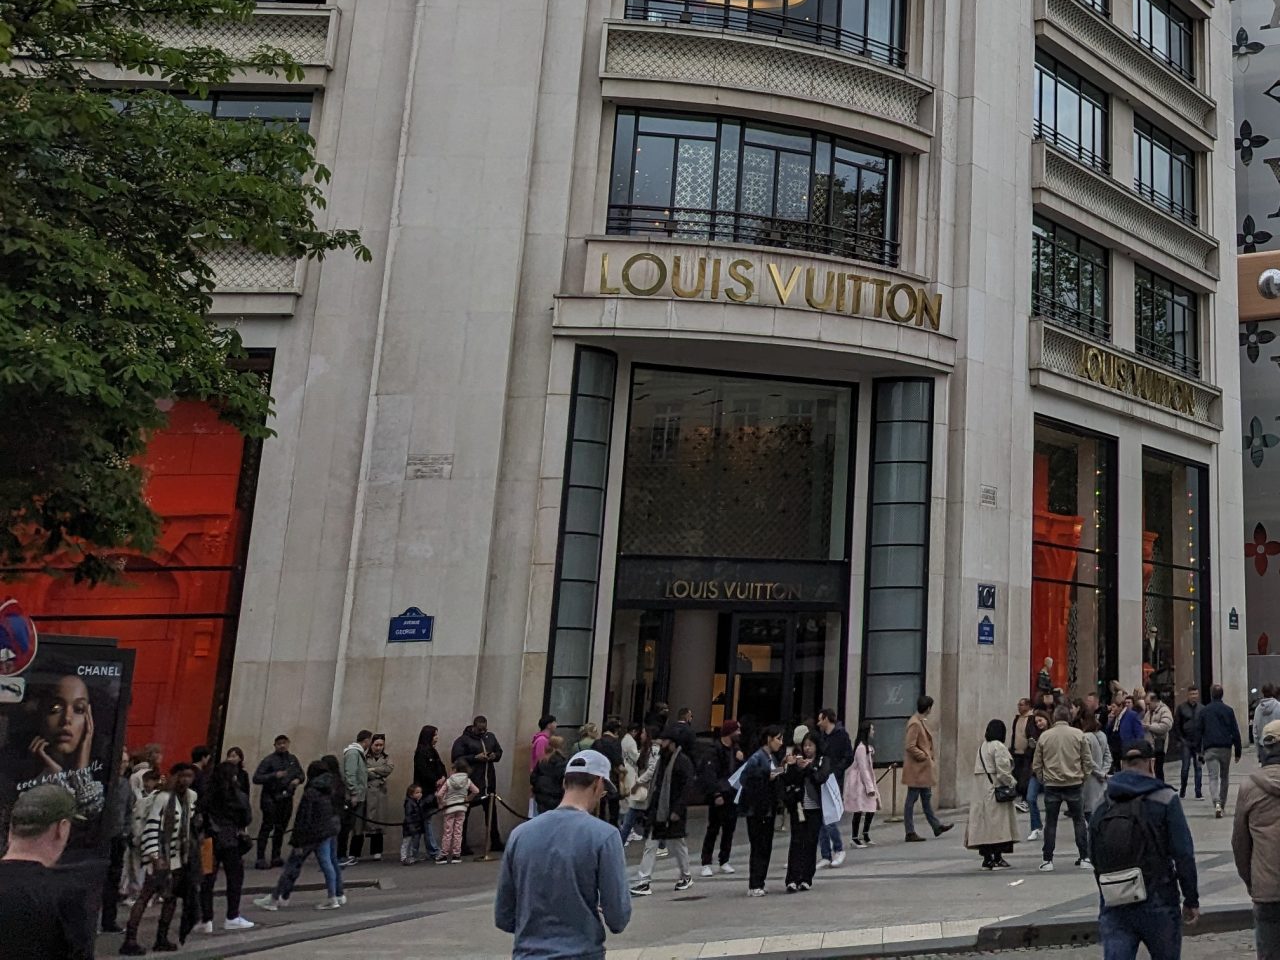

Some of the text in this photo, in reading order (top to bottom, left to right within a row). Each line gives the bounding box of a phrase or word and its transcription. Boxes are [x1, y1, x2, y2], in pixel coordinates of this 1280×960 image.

[599, 251, 944, 332] LOUIS VUITTON
[1079, 343, 1131, 392] LOUIS
[665, 579, 801, 601] LOUIS VUITTON
[77, 665, 121, 677] CHANEL
